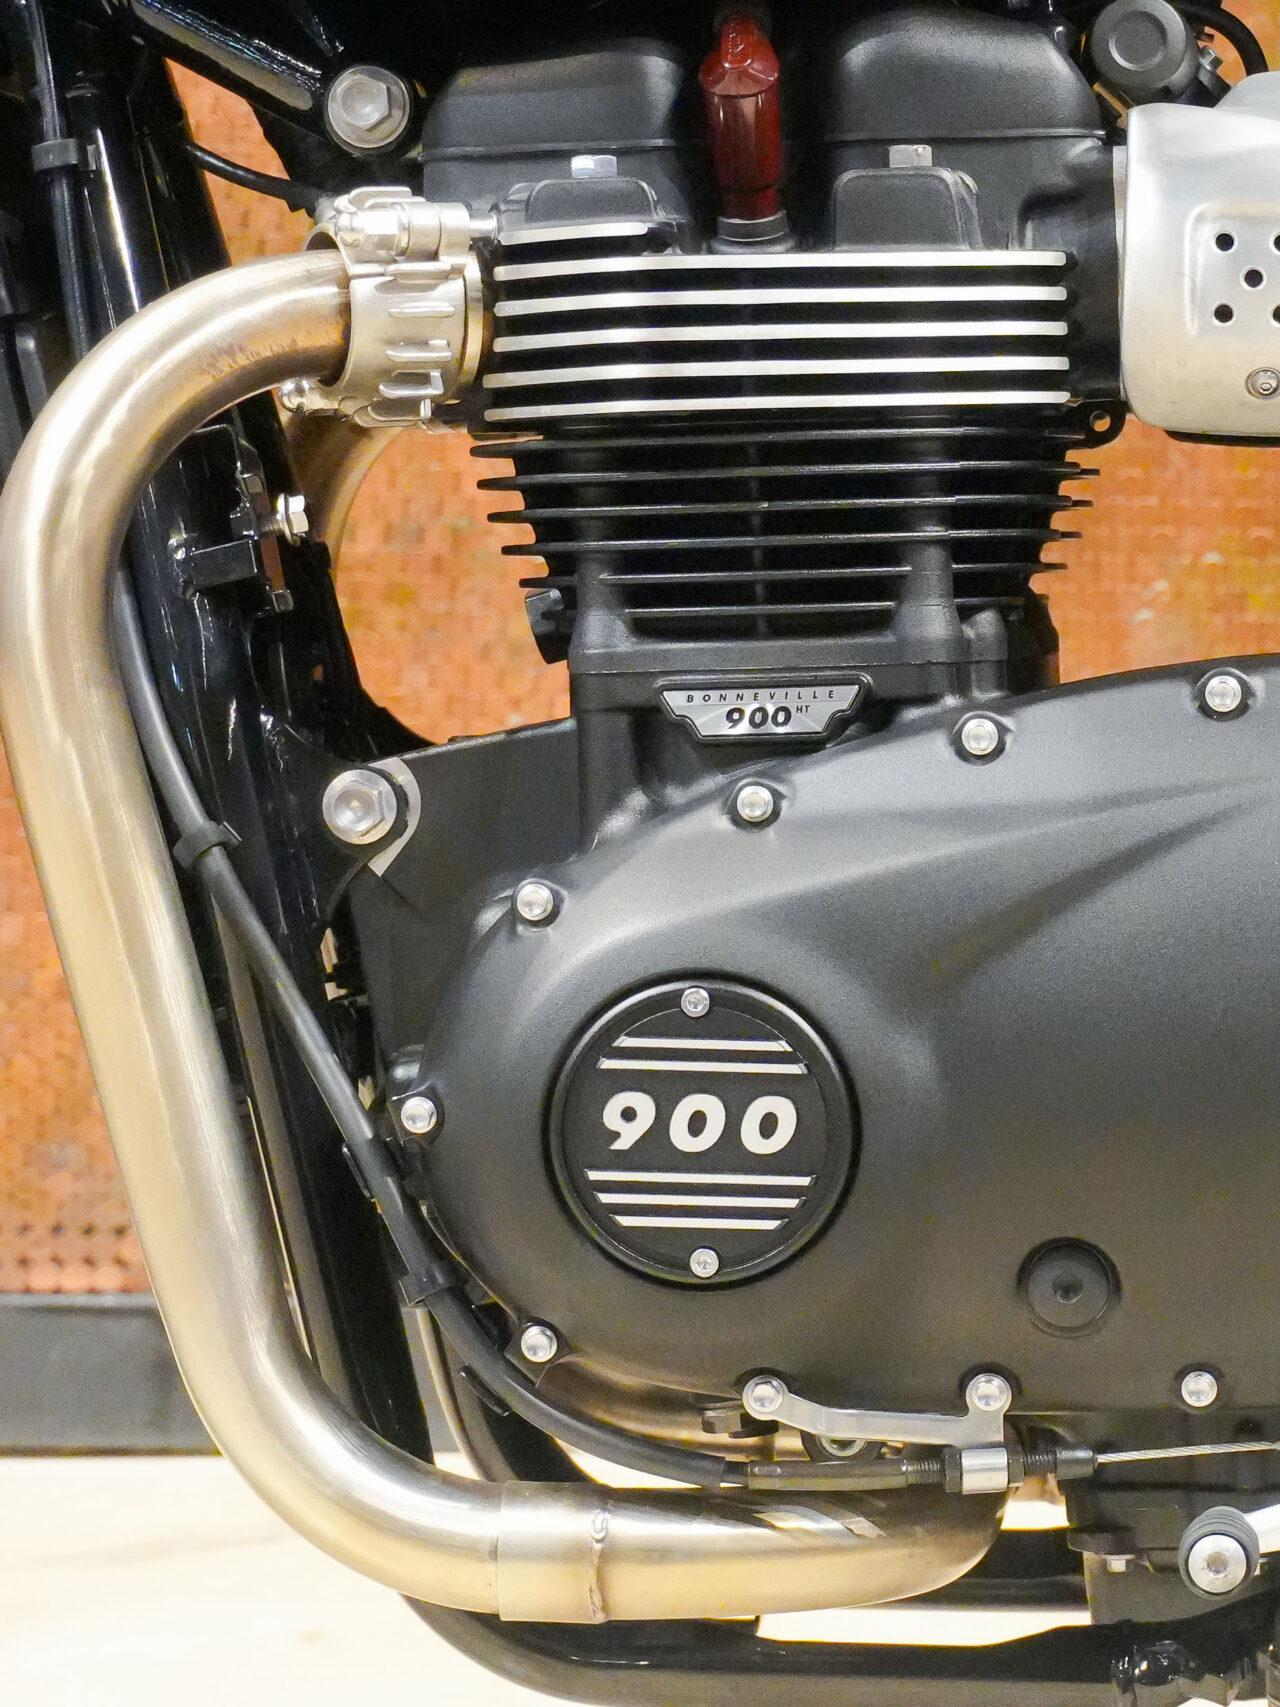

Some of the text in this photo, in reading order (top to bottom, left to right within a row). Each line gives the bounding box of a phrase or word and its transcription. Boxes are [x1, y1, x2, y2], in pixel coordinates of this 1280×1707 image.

[687, 690, 834, 703] BONNEVILLE
[725, 705, 811, 729] 900 HT
[602, 1090, 798, 1155] 900
